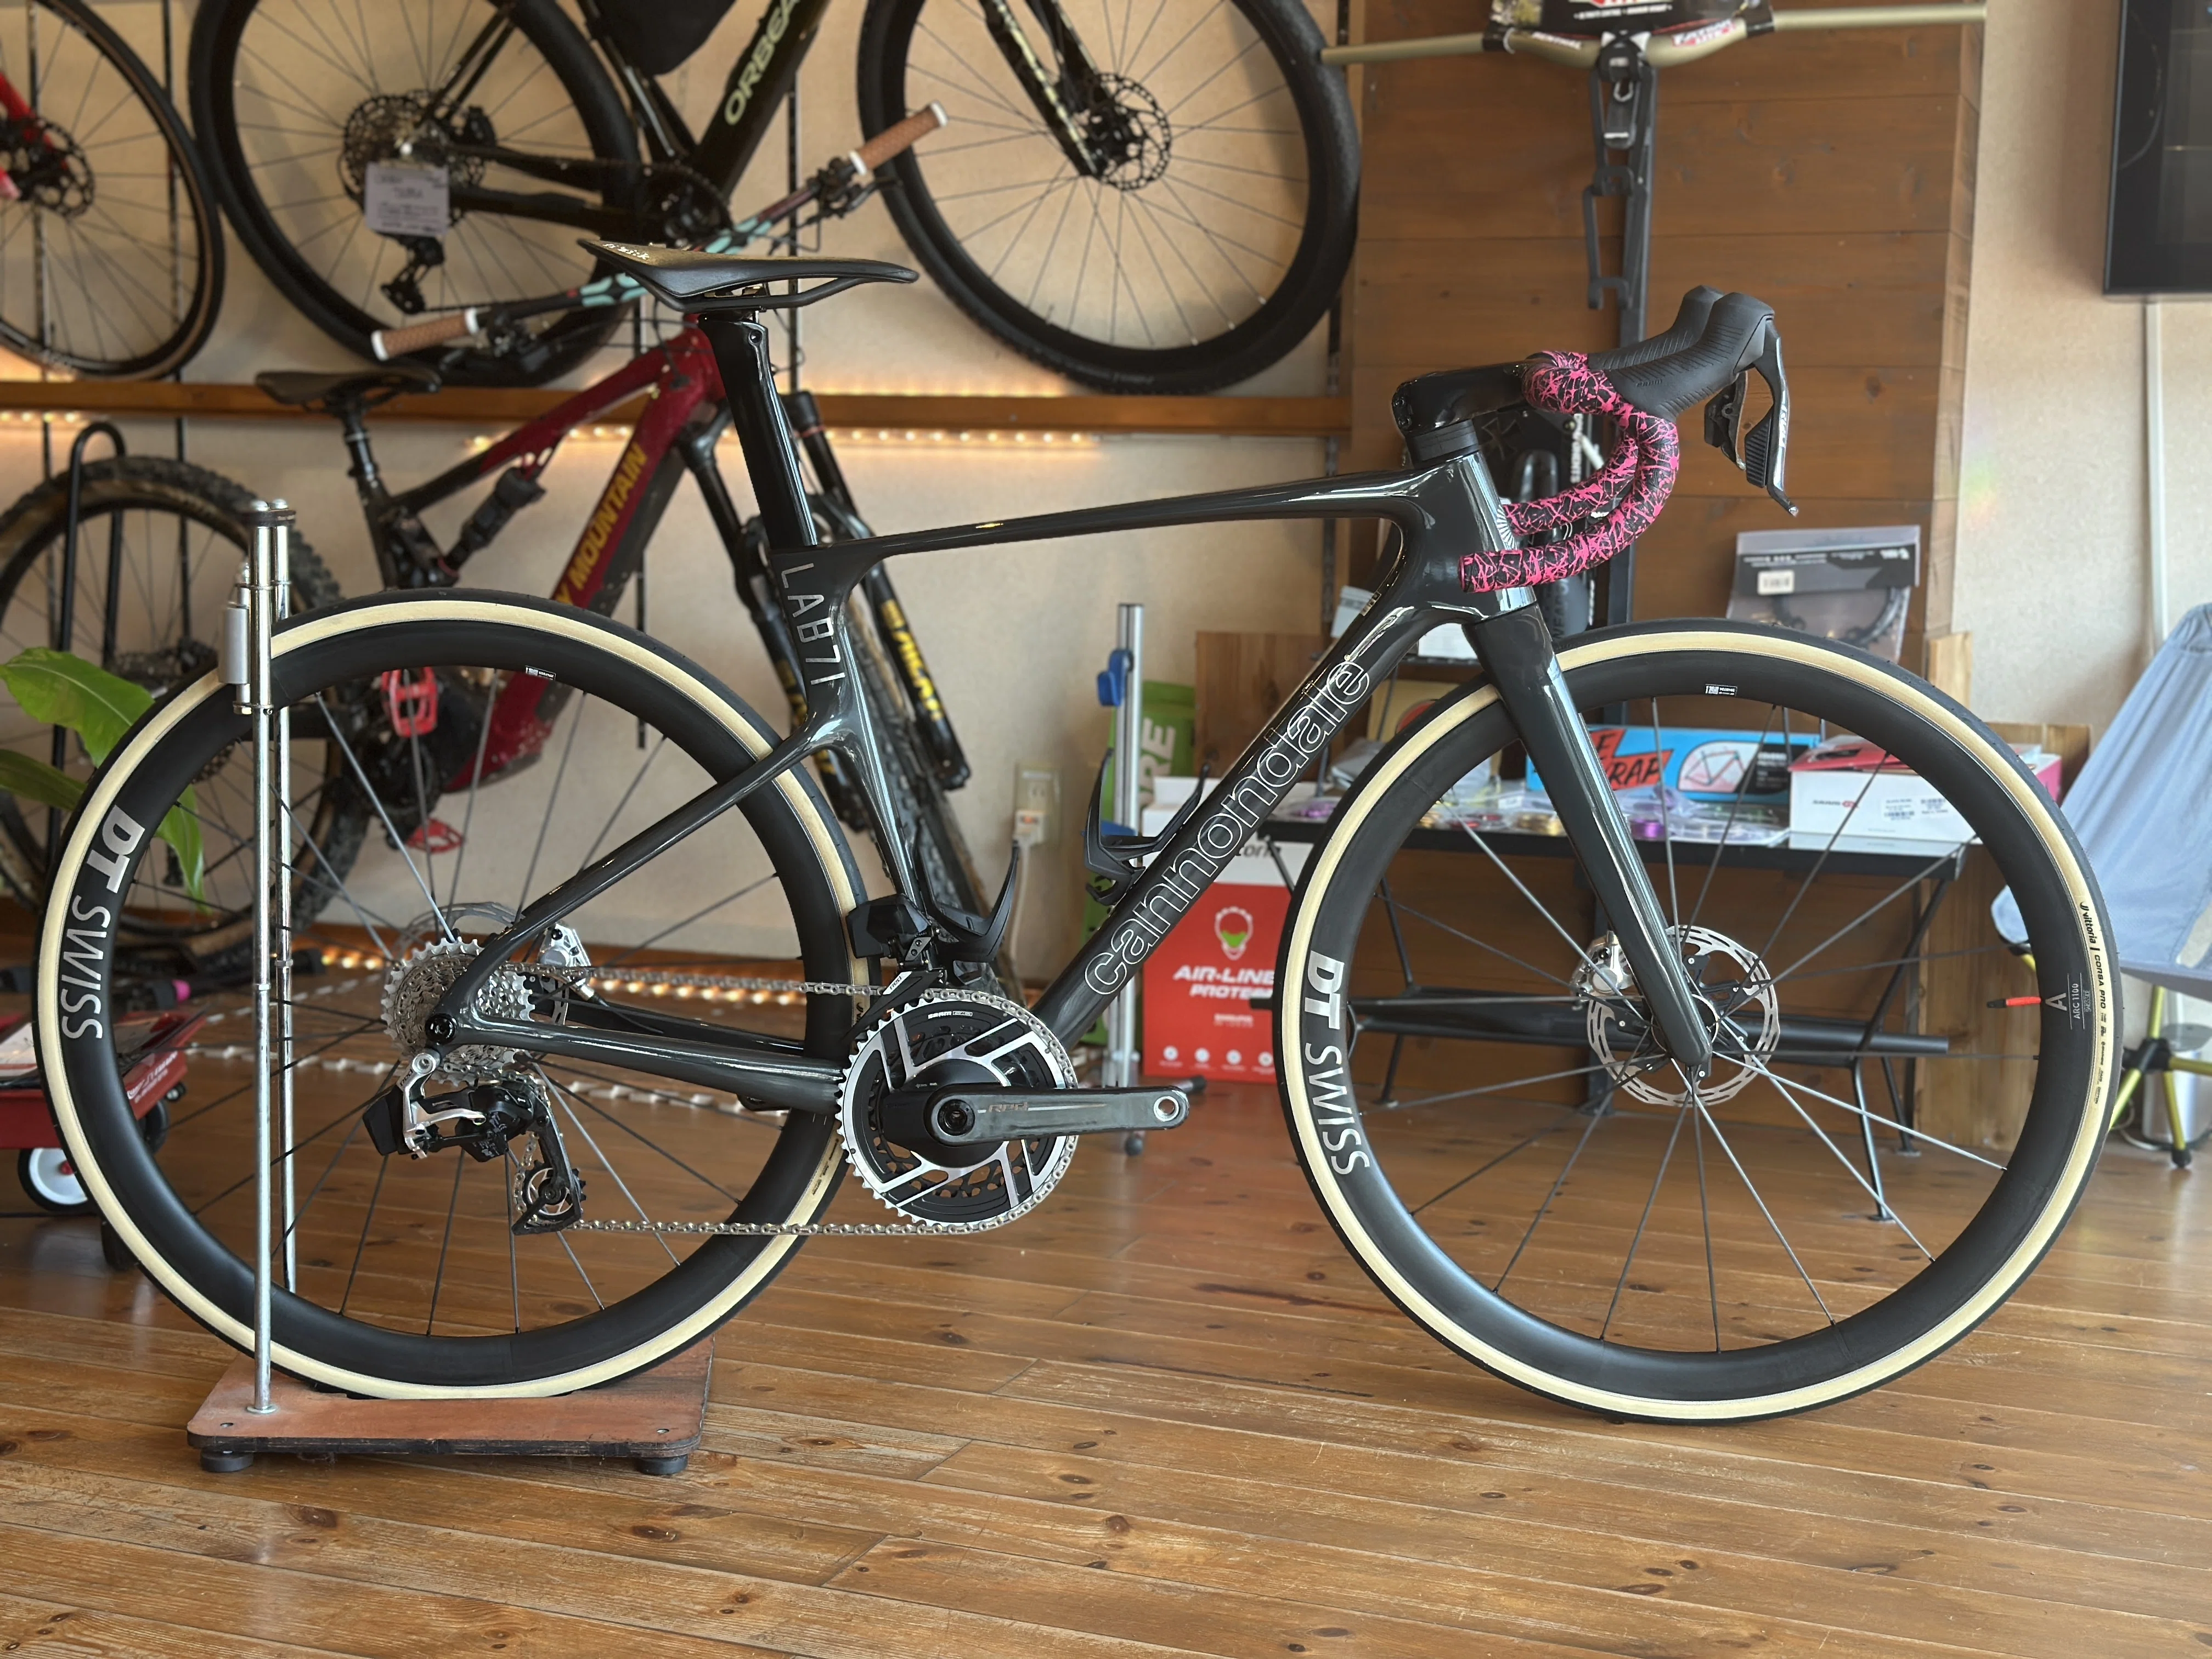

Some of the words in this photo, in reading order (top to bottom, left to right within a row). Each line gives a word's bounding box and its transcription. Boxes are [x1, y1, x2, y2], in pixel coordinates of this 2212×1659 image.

[568, 441, 647, 591] MOUNTAIN
[781, 562, 846, 686] LAB71
[87, 805, 145, 893] DT
[1085, 661, 1370, 995] cannondale
[61, 895, 111, 1039] SWISS
[1304, 950, 1345, 1030] DT
[2095, 954, 2104, 986] CORSA
[1305, 1042, 1370, 1175] SWISS
